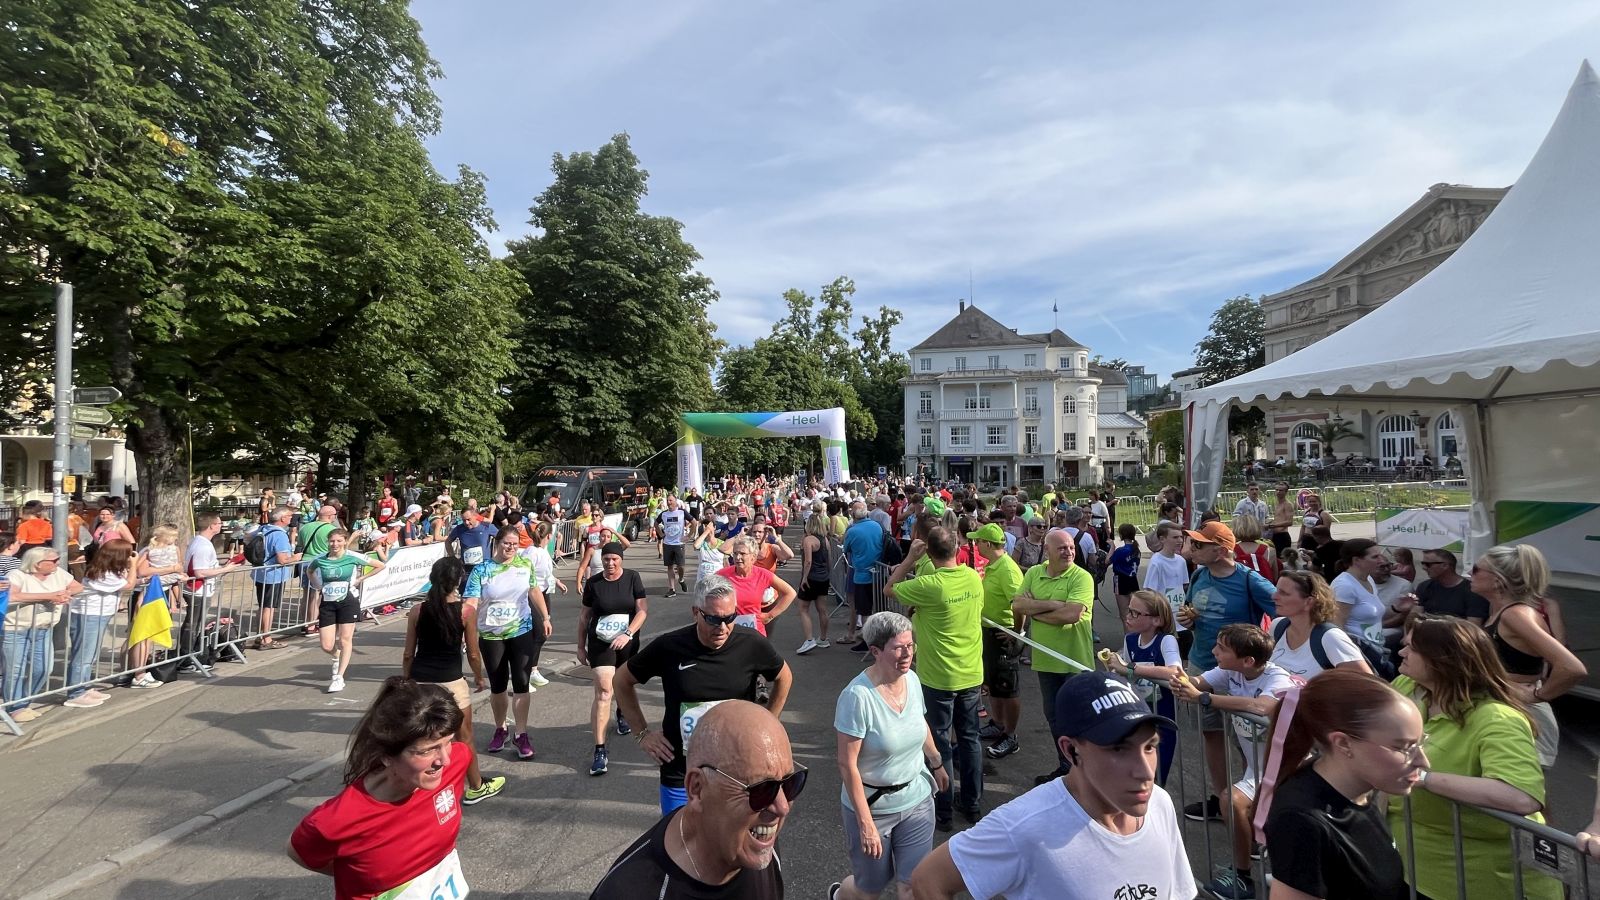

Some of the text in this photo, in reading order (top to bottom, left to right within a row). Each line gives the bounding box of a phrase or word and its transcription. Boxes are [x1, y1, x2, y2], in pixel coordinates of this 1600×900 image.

[324, 586, 347, 595] 2060
[489, 606, 518, 618] 2347
[598, 621, 629, 632] 2698
[1091, 690, 1136, 715] PUMA
